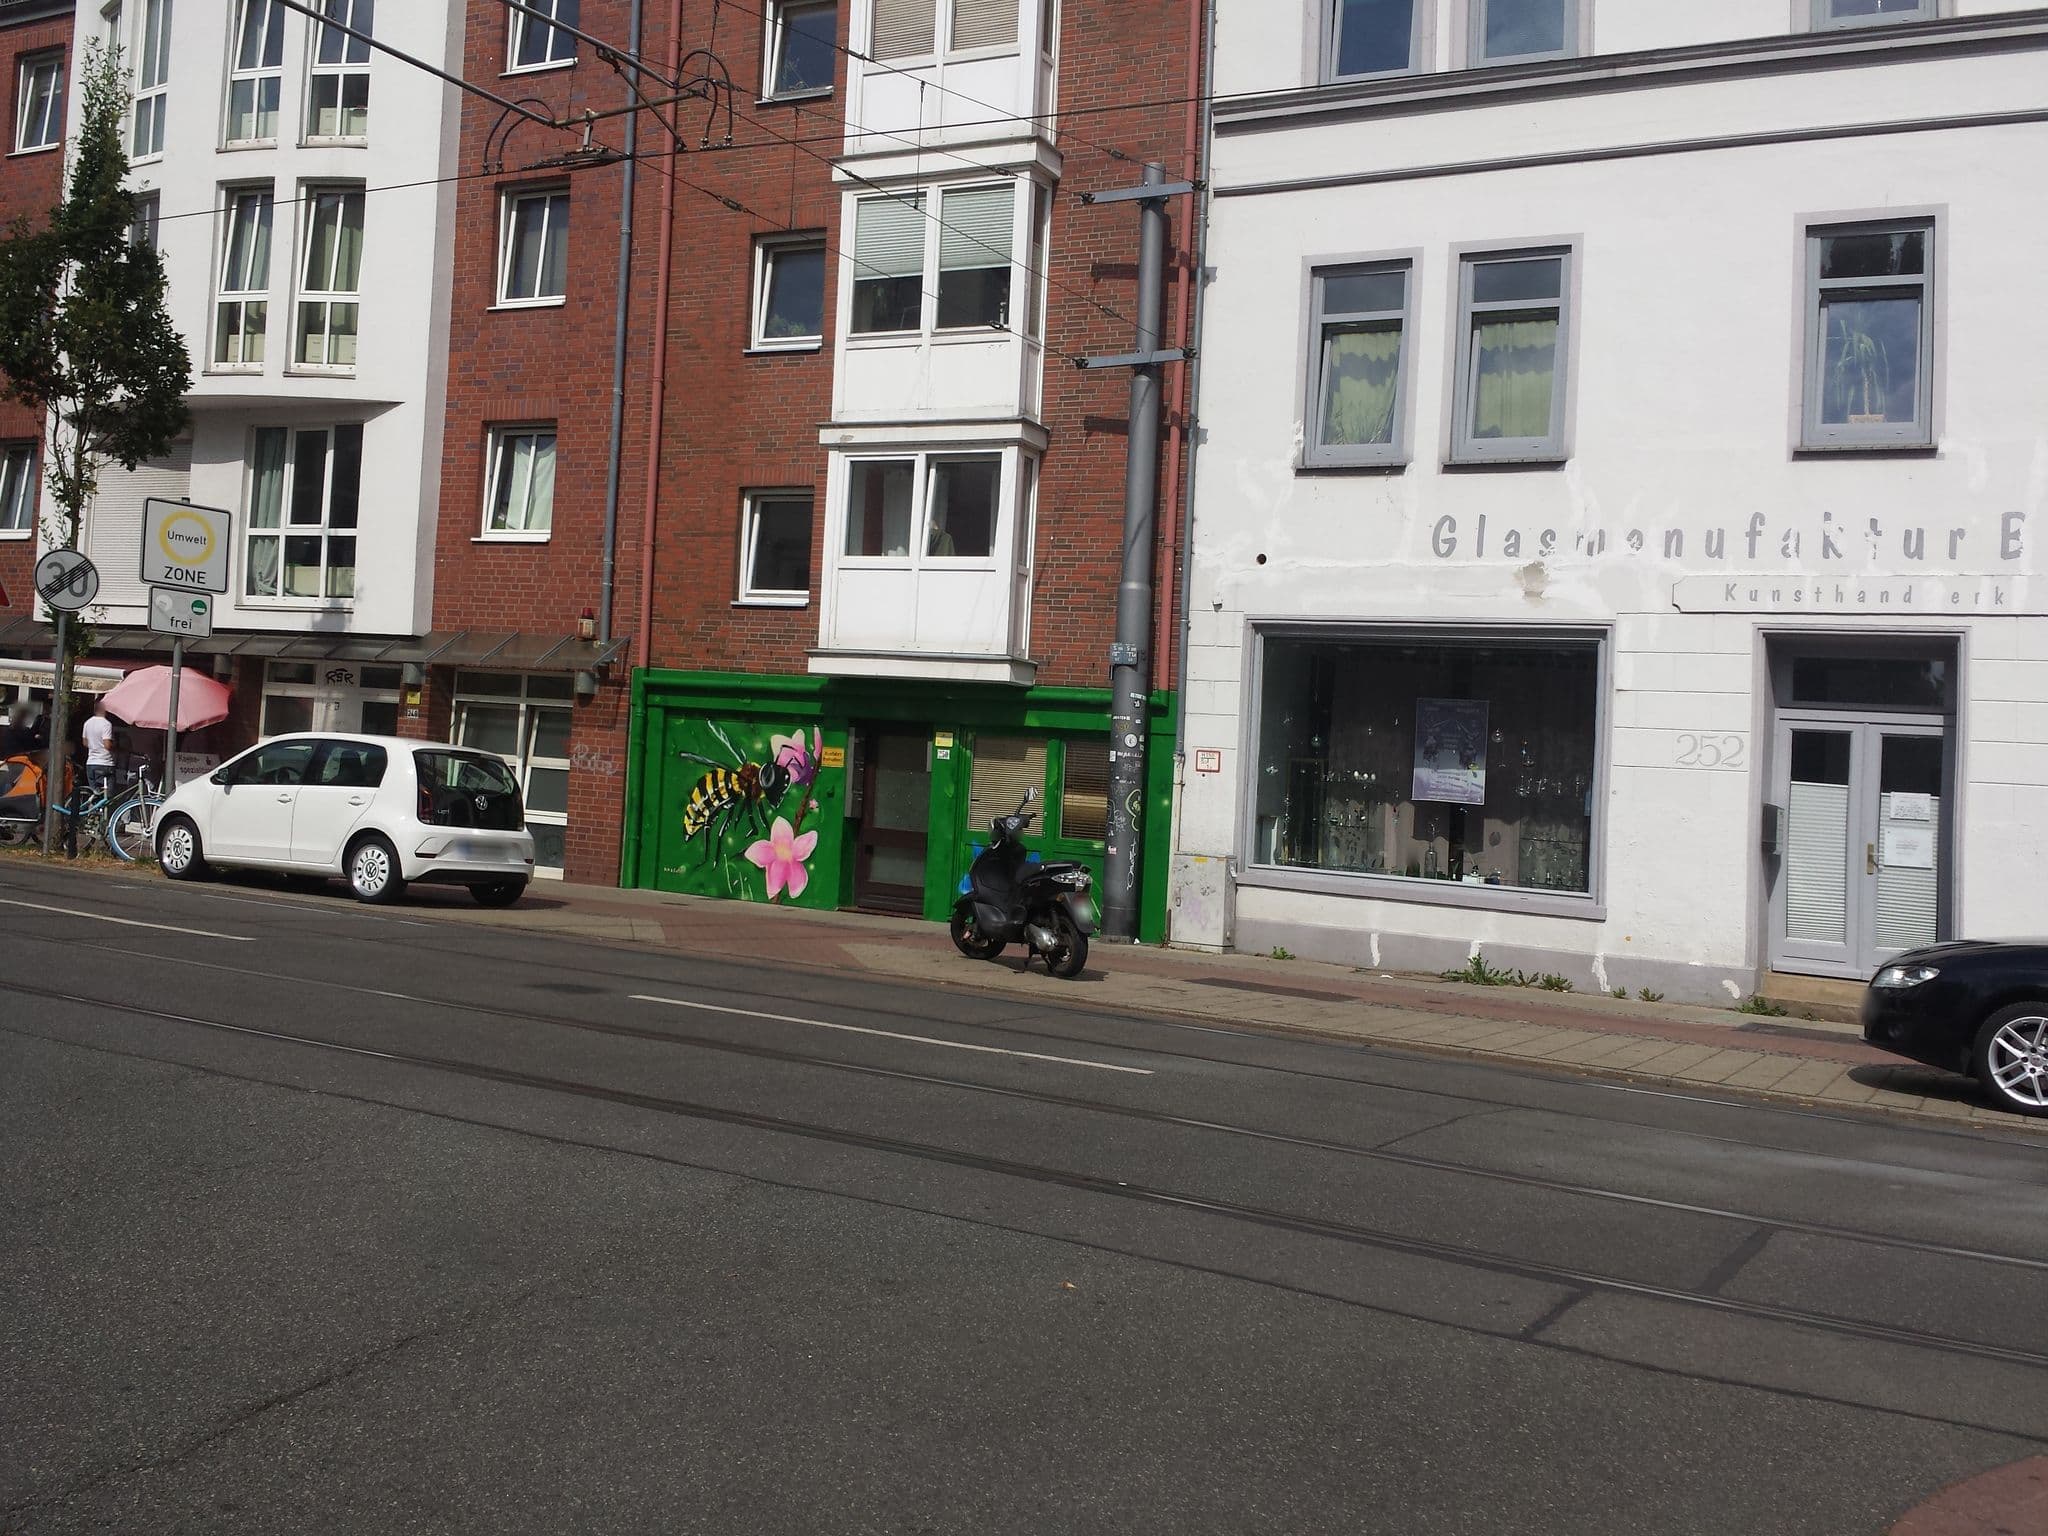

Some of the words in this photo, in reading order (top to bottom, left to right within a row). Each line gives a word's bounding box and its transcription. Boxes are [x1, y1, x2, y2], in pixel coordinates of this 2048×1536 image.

[167, 530, 207, 546] Umwelt
[164, 565, 207, 585] ZONE
[1724, 582, 2004, 606] Kunsthanderk
[170, 616, 193, 630] frei
[1675, 733, 1744, 768] 252
